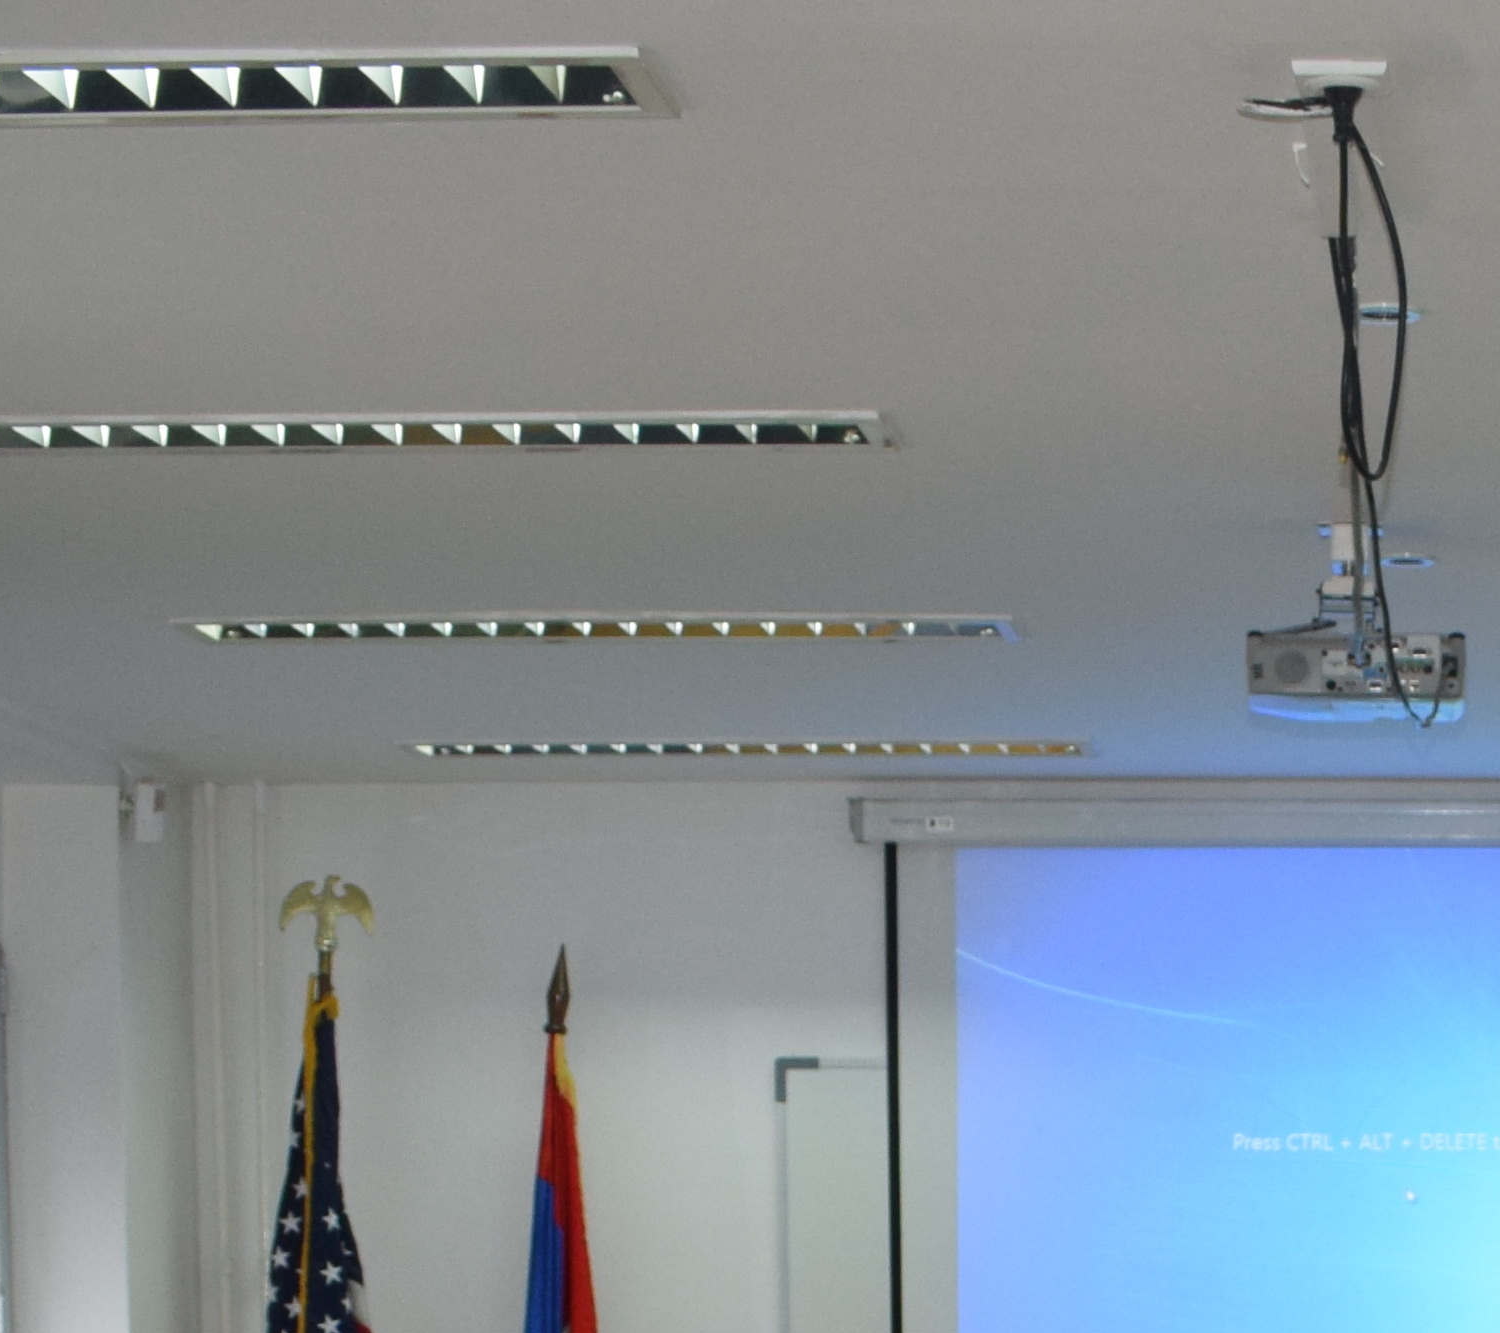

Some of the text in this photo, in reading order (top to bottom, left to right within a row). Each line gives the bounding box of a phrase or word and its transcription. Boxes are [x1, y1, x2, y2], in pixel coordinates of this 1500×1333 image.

[1233, 1133, 1280, 1151] Press
[1286, 1133, 1334, 1150] CTRL
[1359, 1133, 1393, 1150] ALT
[1420, 1133, 1487, 1150] DELETE
